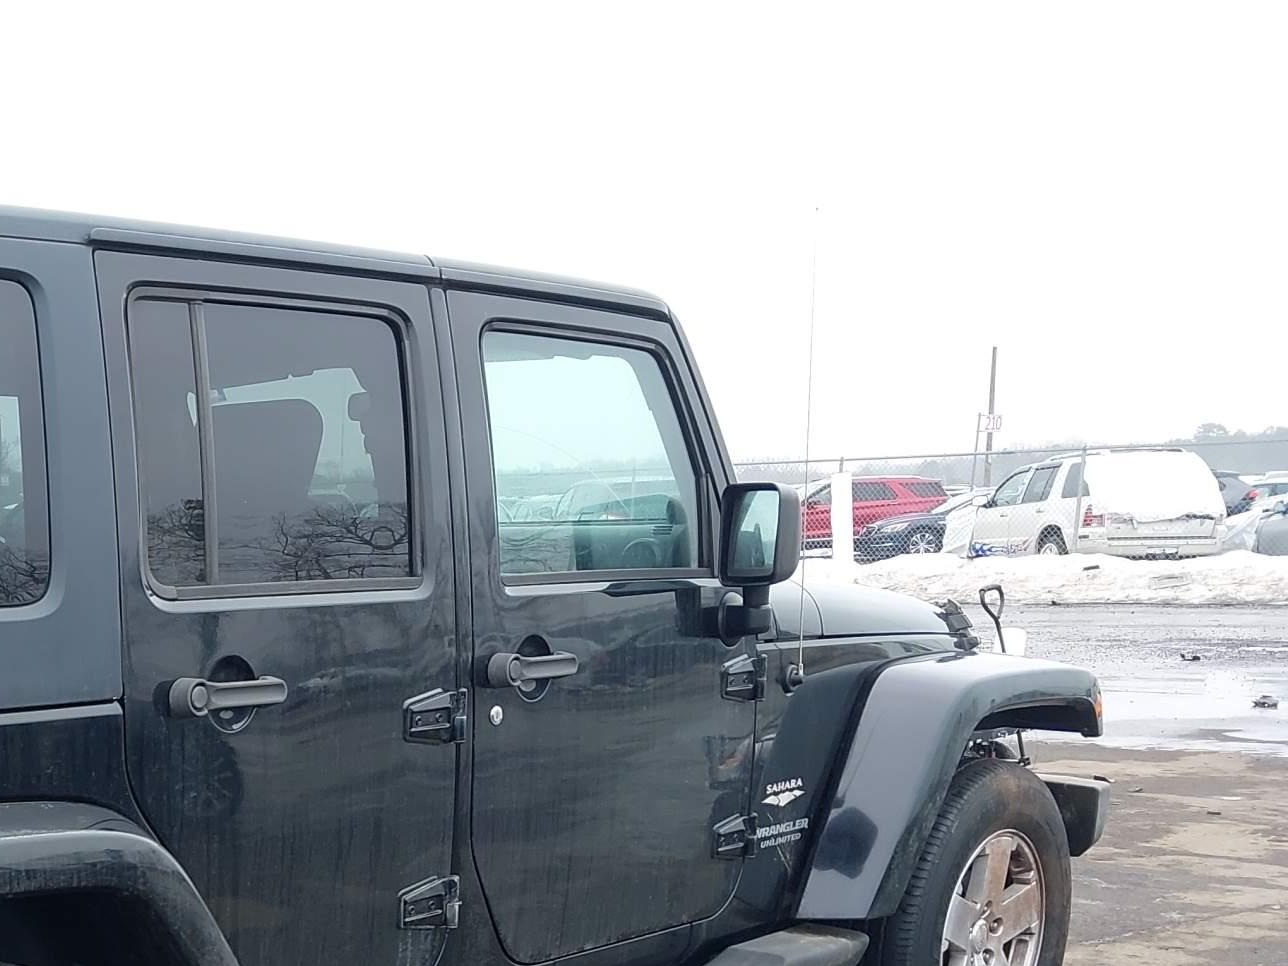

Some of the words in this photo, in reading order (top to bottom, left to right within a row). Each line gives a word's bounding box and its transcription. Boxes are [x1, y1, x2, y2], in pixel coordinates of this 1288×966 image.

[766, 777, 803, 795] SAHARA
[756, 818, 809, 839] WRANGLER
[760, 832, 802, 849] UNLIMITED
